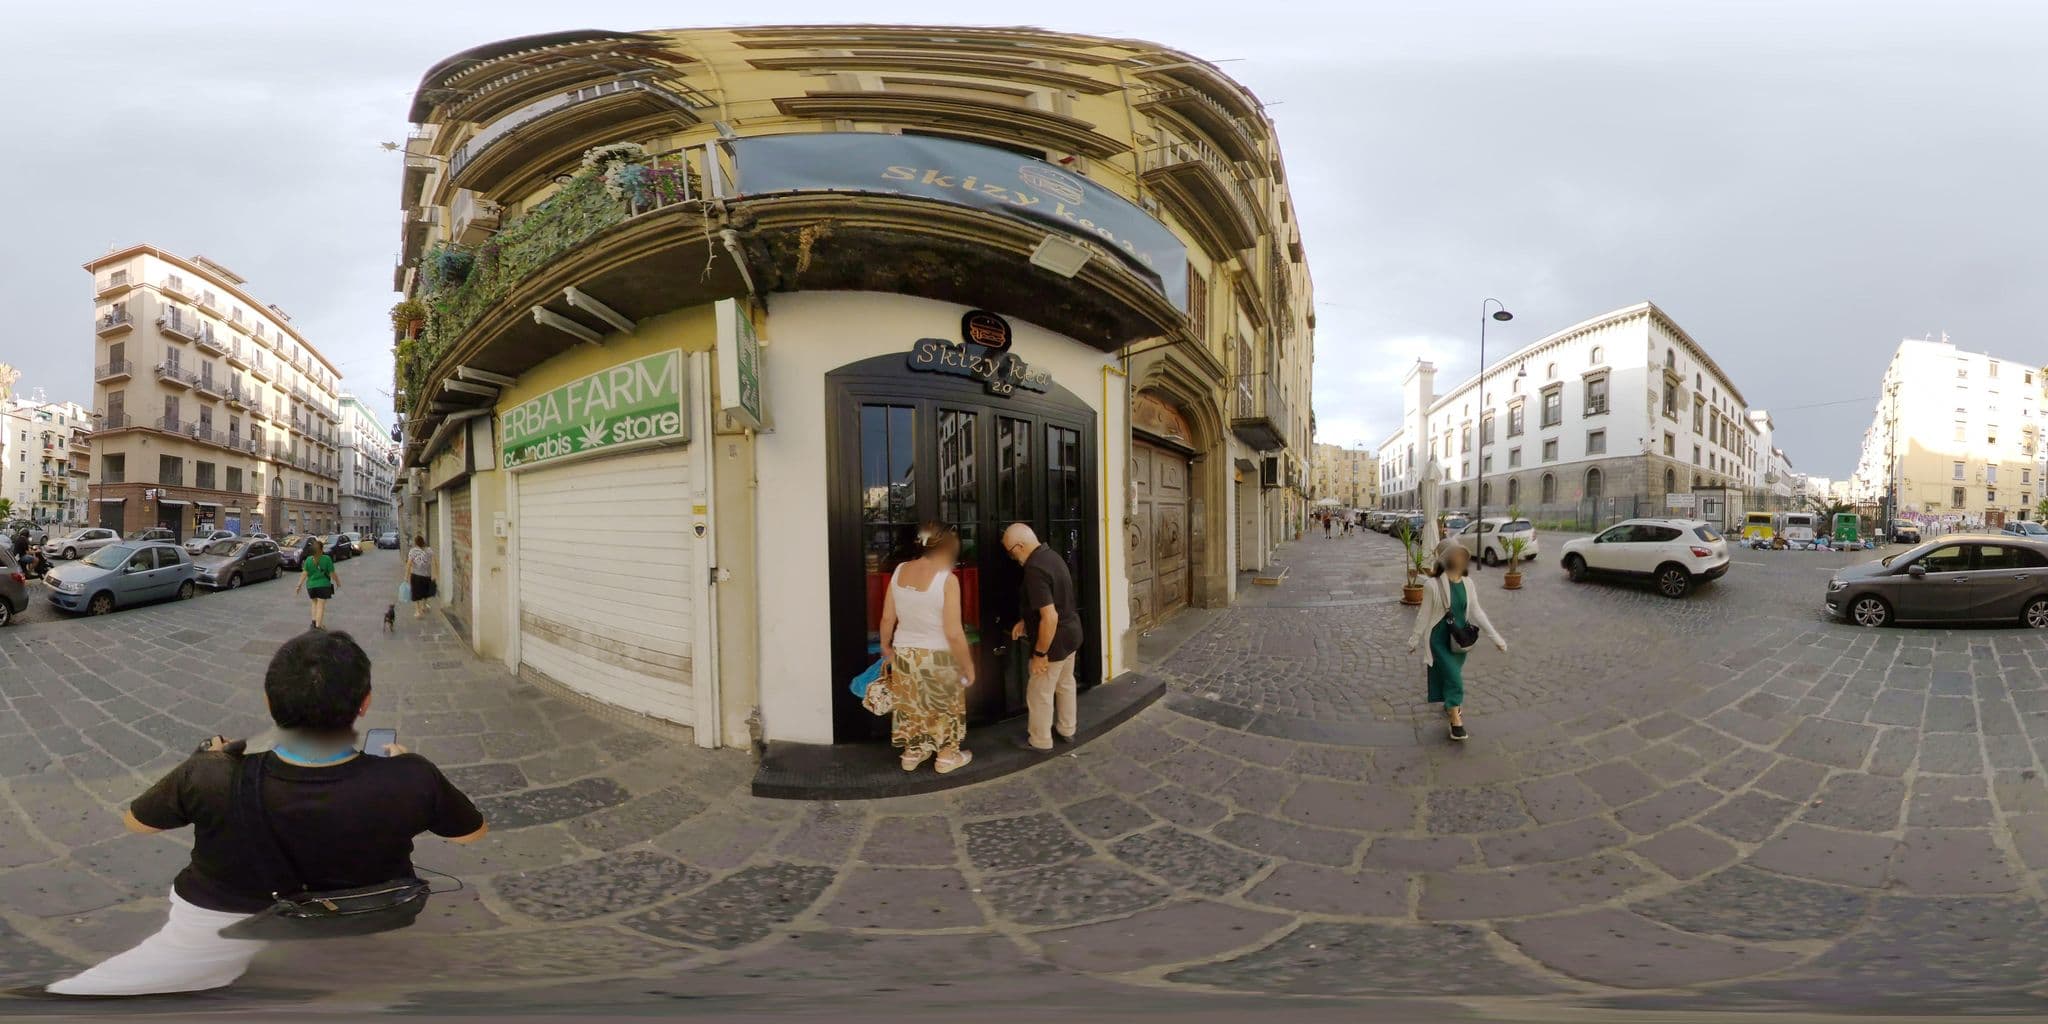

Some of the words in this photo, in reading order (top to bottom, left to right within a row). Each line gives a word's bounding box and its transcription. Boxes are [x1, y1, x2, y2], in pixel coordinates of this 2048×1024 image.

[881, 165, 1039, 206] Skizy
[917, 343, 1000, 378] Skizy
[1009, 358, 1050, 386] kea
[502, 393, 562, 443] ERBA
[567, 352, 679, 422] FARM
[992, 381, 1013, 394] 2.0
[504, 432, 572, 468] canabis
[613, 411, 680, 443] store
